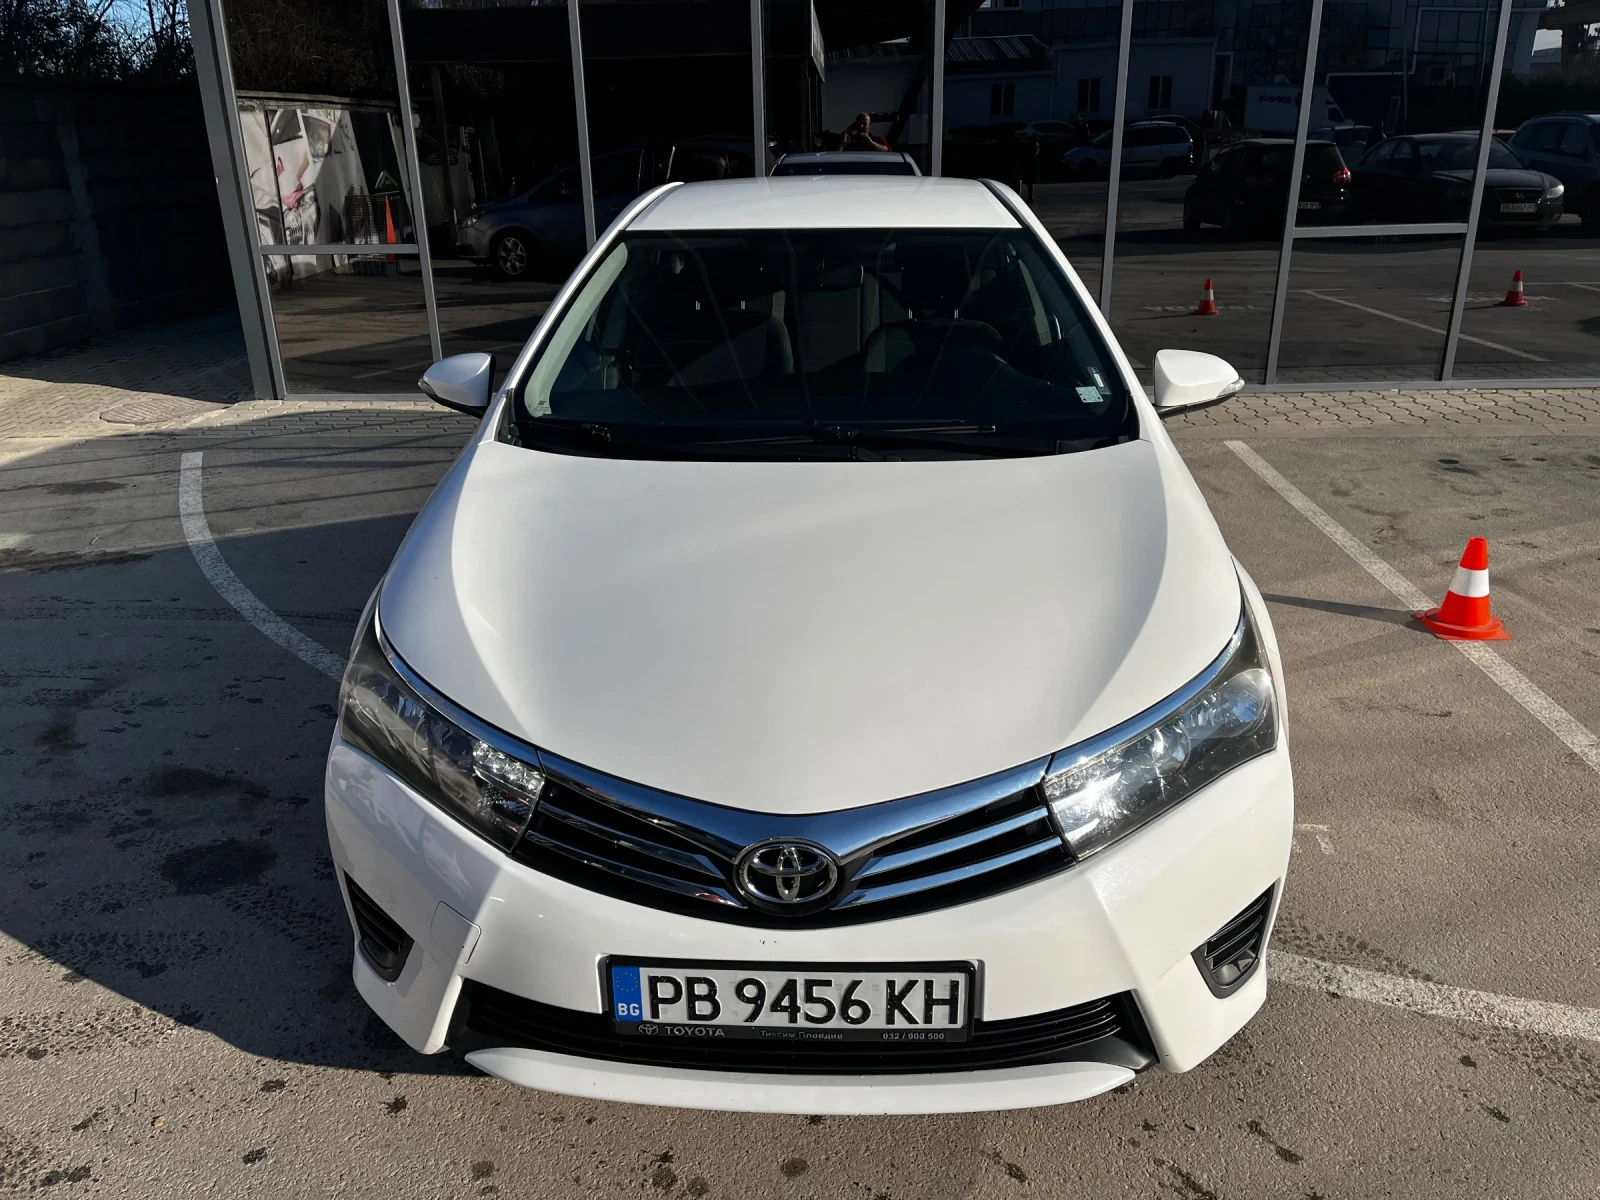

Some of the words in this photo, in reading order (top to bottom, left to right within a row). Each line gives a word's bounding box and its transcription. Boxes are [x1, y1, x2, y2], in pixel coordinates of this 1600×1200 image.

[648, 974, 722, 1022] PB
[734, 977, 872, 1025] 9456
[886, 979, 960, 1025] KH
[617, 1002, 640, 1016] BG
[664, 1025, 725, 1037] TOYOTA
[799, 1031, 843, 1040] Пловдив
[882, 1031, 900, 1040] 032
[907, 1032, 925, 1040] 900
[928, 1032, 945, 1040] 500
